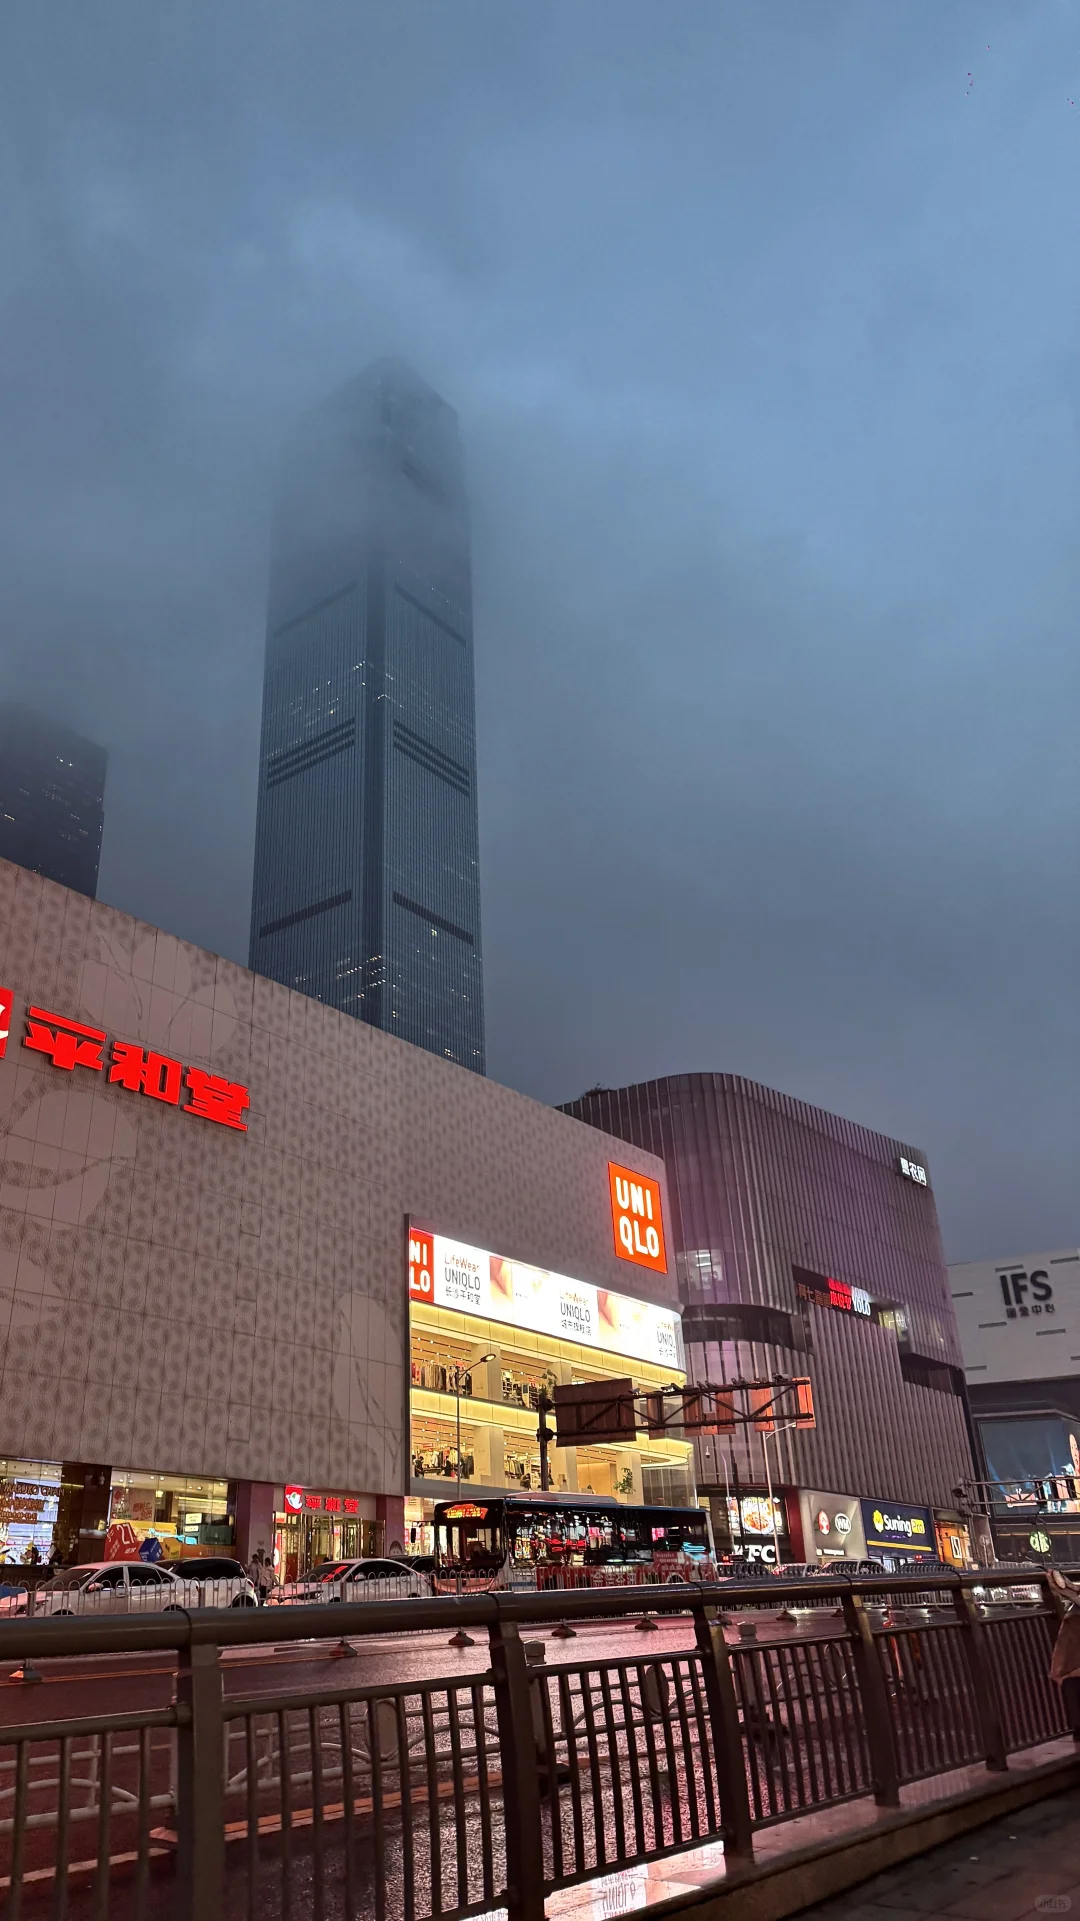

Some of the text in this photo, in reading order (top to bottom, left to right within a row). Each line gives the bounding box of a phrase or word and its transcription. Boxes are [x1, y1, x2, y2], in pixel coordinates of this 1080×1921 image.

[23, 1006, 251, 1131] 平和堂
[615, 1176, 654, 1220] UNI
[618, 1215, 660, 1258] QLO
[445, 1252, 479, 1273] LifeWear
[445, 1267, 481, 1291] UNIQLO
[999, 1270, 1053, 1306] IFS
[560, 1302, 591, 1322] UNIQLO
[656, 1330, 676, 1348] UNIQ
[305, 1494, 360, 1514] 平和堂
[116, 1524, 135, 1545] 27
[883, 1514, 924, 1537] Suning Pro
[732, 1545, 776, 1562] KFC
